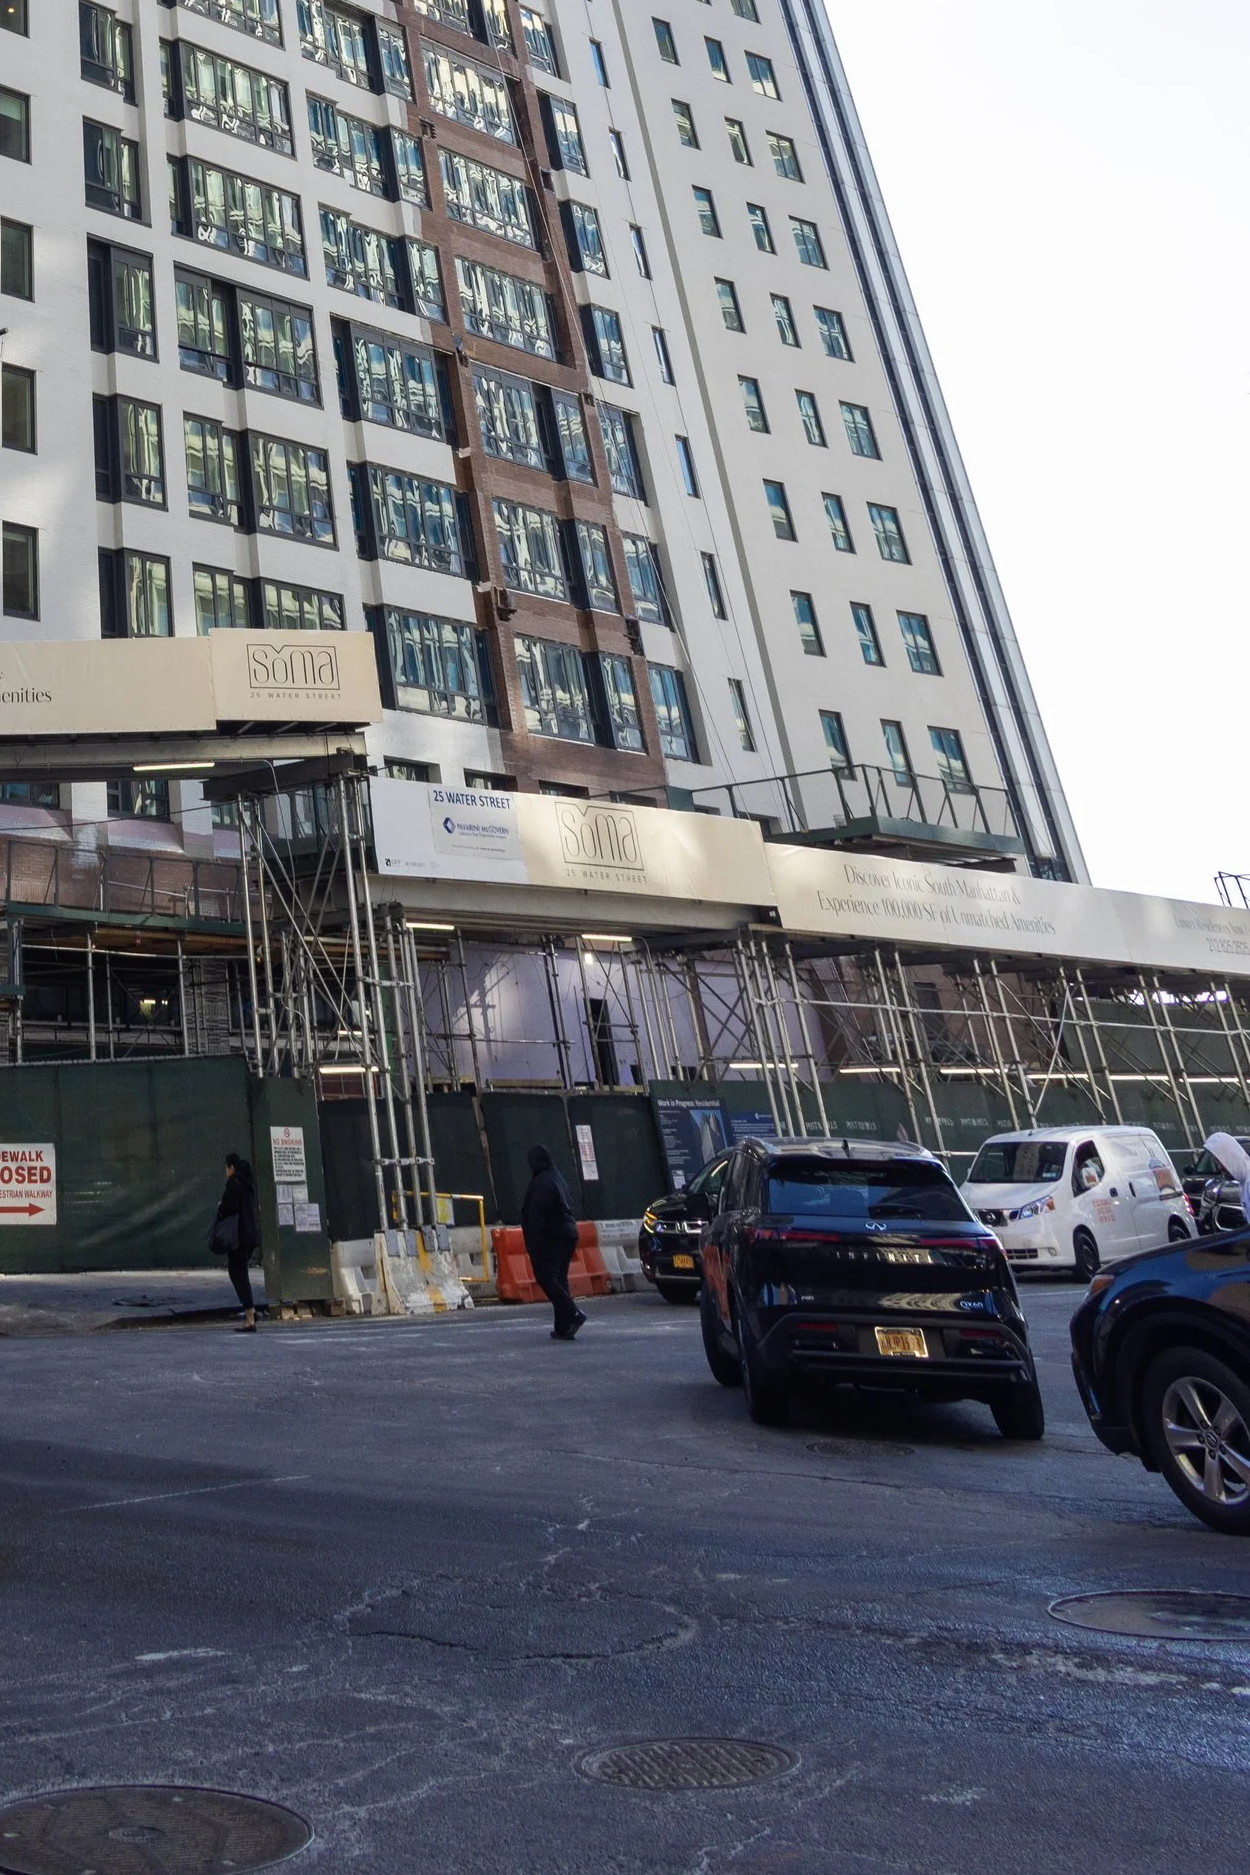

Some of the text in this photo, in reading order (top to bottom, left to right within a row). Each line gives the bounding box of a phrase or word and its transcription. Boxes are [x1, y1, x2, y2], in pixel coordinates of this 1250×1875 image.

[433, 790, 510, 809] 25 WATER STREET
[457, 823, 480, 832] PAVARINI
[481, 825, 509, 835] McGOVERN
[582, 870, 610, 879] WATER
[615, 874, 647, 883] STREET
[844, 864, 891, 888] Discover
[892, 871, 924, 893] Iconic
[924, 876, 957, 896] South
[956, 879, 1011, 902] Manhattan
[817, 890, 879, 917] Experience
[881, 898, 923, 920] 100,000
[951, 906, 1010, 930] Unmatched
[1011, 913, 1056, 935] Amenities
[657, 1099, 670, 1107] Work
[24, 1189, 53, 1199] WALKWAY
[836, 1250, 934, 1264] INFINITI
[960, 1300, 984, 1310] QX60
